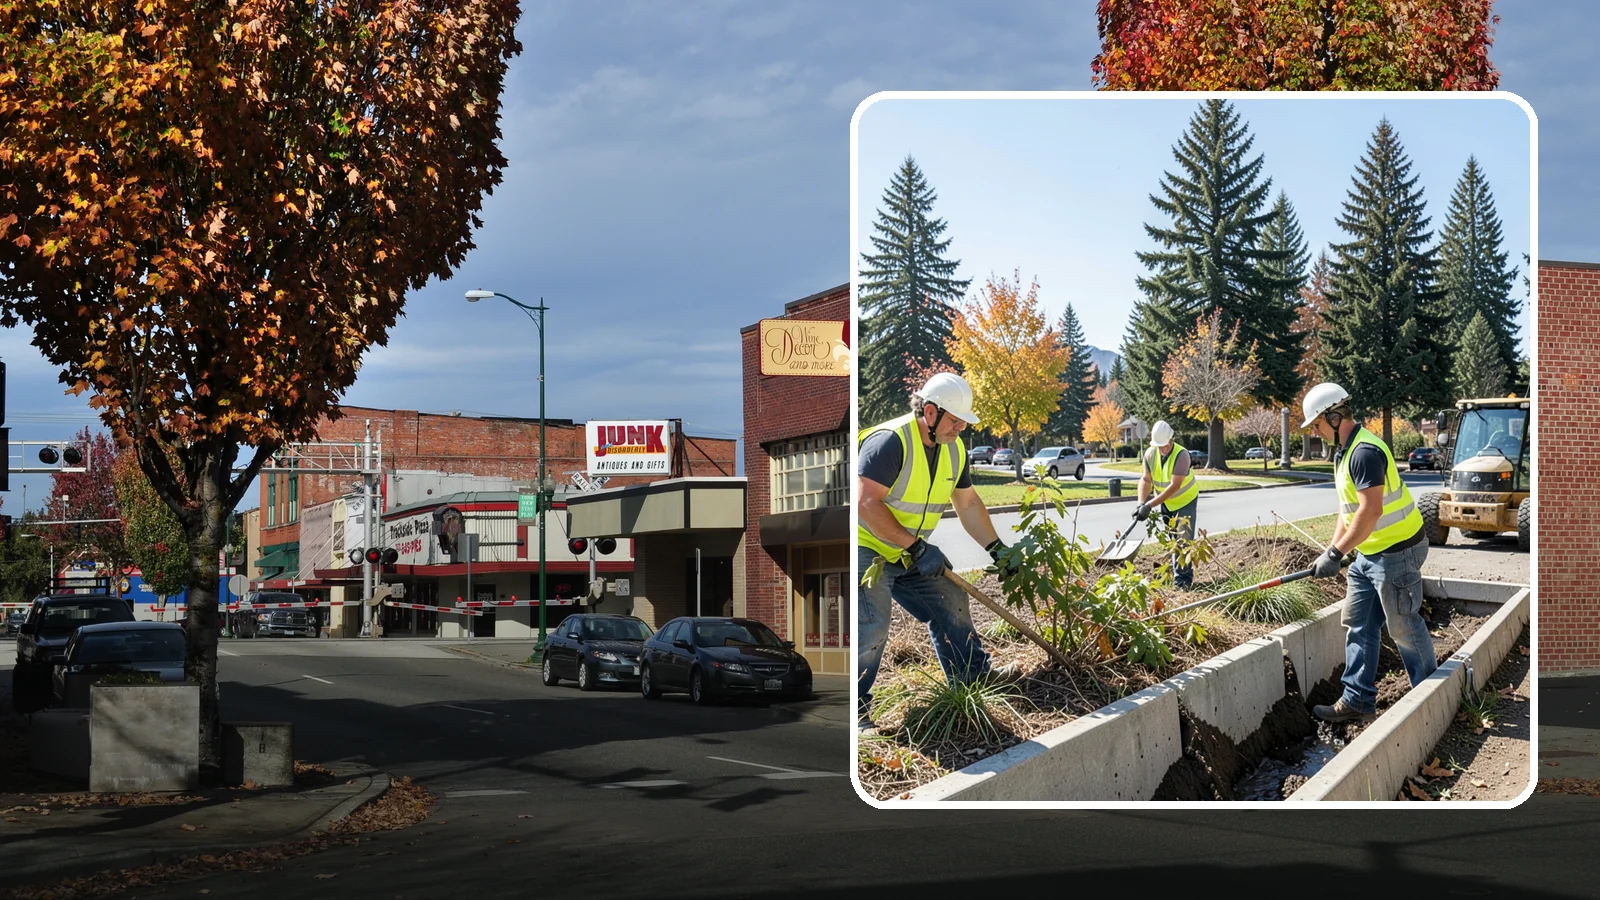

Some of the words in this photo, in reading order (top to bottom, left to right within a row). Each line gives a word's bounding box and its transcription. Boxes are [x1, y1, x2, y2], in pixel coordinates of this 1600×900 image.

[596, 425, 664, 457] JUNK
[607, 446, 646, 454] DISORDERLY
[597, 461, 628, 470] ANTIQUES
[631, 461, 644, 470] AND
[647, 460, 665, 469] GIFTS
[414, 519, 429, 534] Pizza
